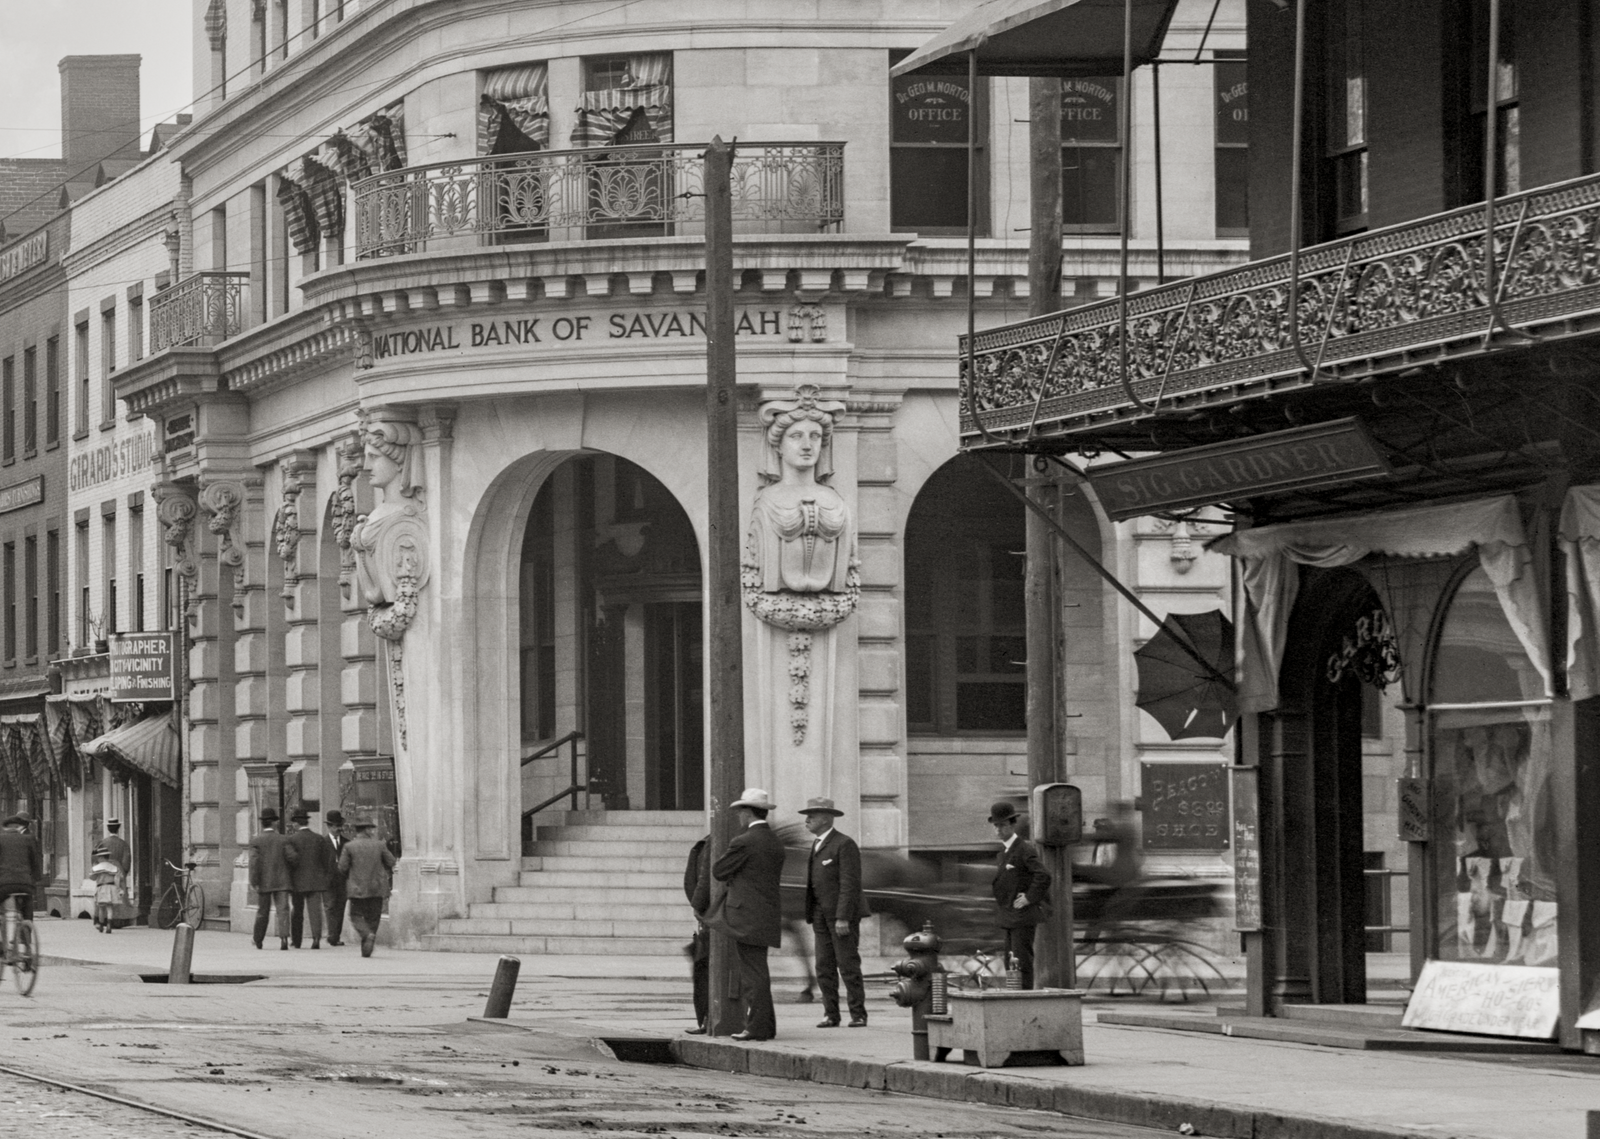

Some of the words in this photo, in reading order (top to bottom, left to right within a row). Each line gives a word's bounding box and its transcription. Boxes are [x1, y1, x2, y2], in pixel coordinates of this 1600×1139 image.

[908, 108, 962, 121] OFFICE
[1061, 107, 1103, 121] FFICE
[374, 325, 460, 360] NATIONAL
[471, 318, 541, 347] BANK
[552, 316, 592, 341] OF
[608, 309, 781, 340] SAVANAH
[70, 435, 119, 492] GIRARD'S
[119, 430, 154, 476] STUDIO
[137, 675, 172, 689] FINISHING
[1403, 820, 1426, 837] HATS
